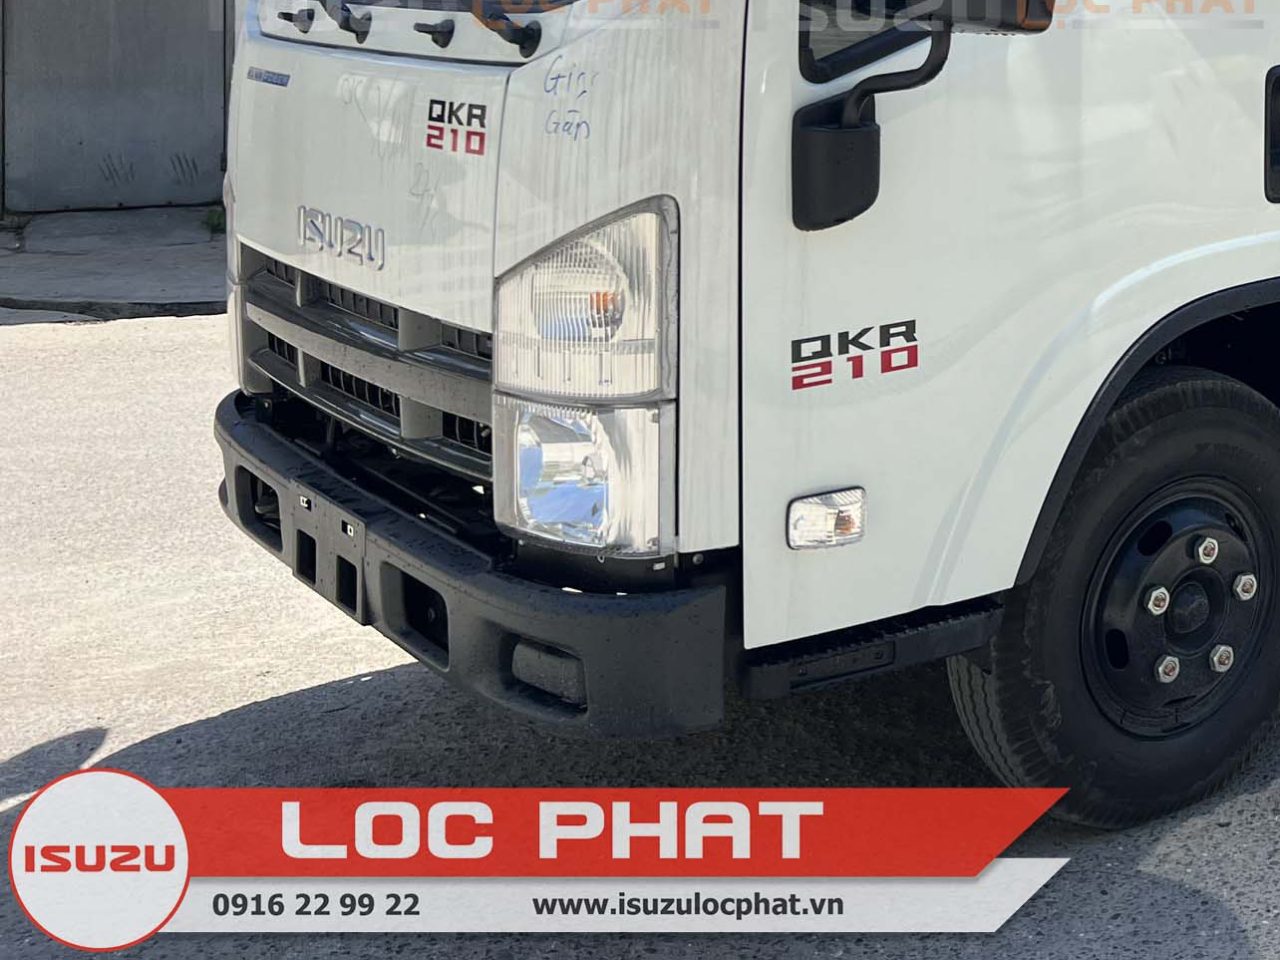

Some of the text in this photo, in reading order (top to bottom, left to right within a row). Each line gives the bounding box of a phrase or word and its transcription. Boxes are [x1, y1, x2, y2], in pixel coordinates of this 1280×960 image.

[428, 99, 487, 128] QKR
[426, 125, 487, 156] 210
[297, 205, 385, 271] ISUZU
[791, 319, 918, 364] QKR
[791, 344, 918, 390] 210
